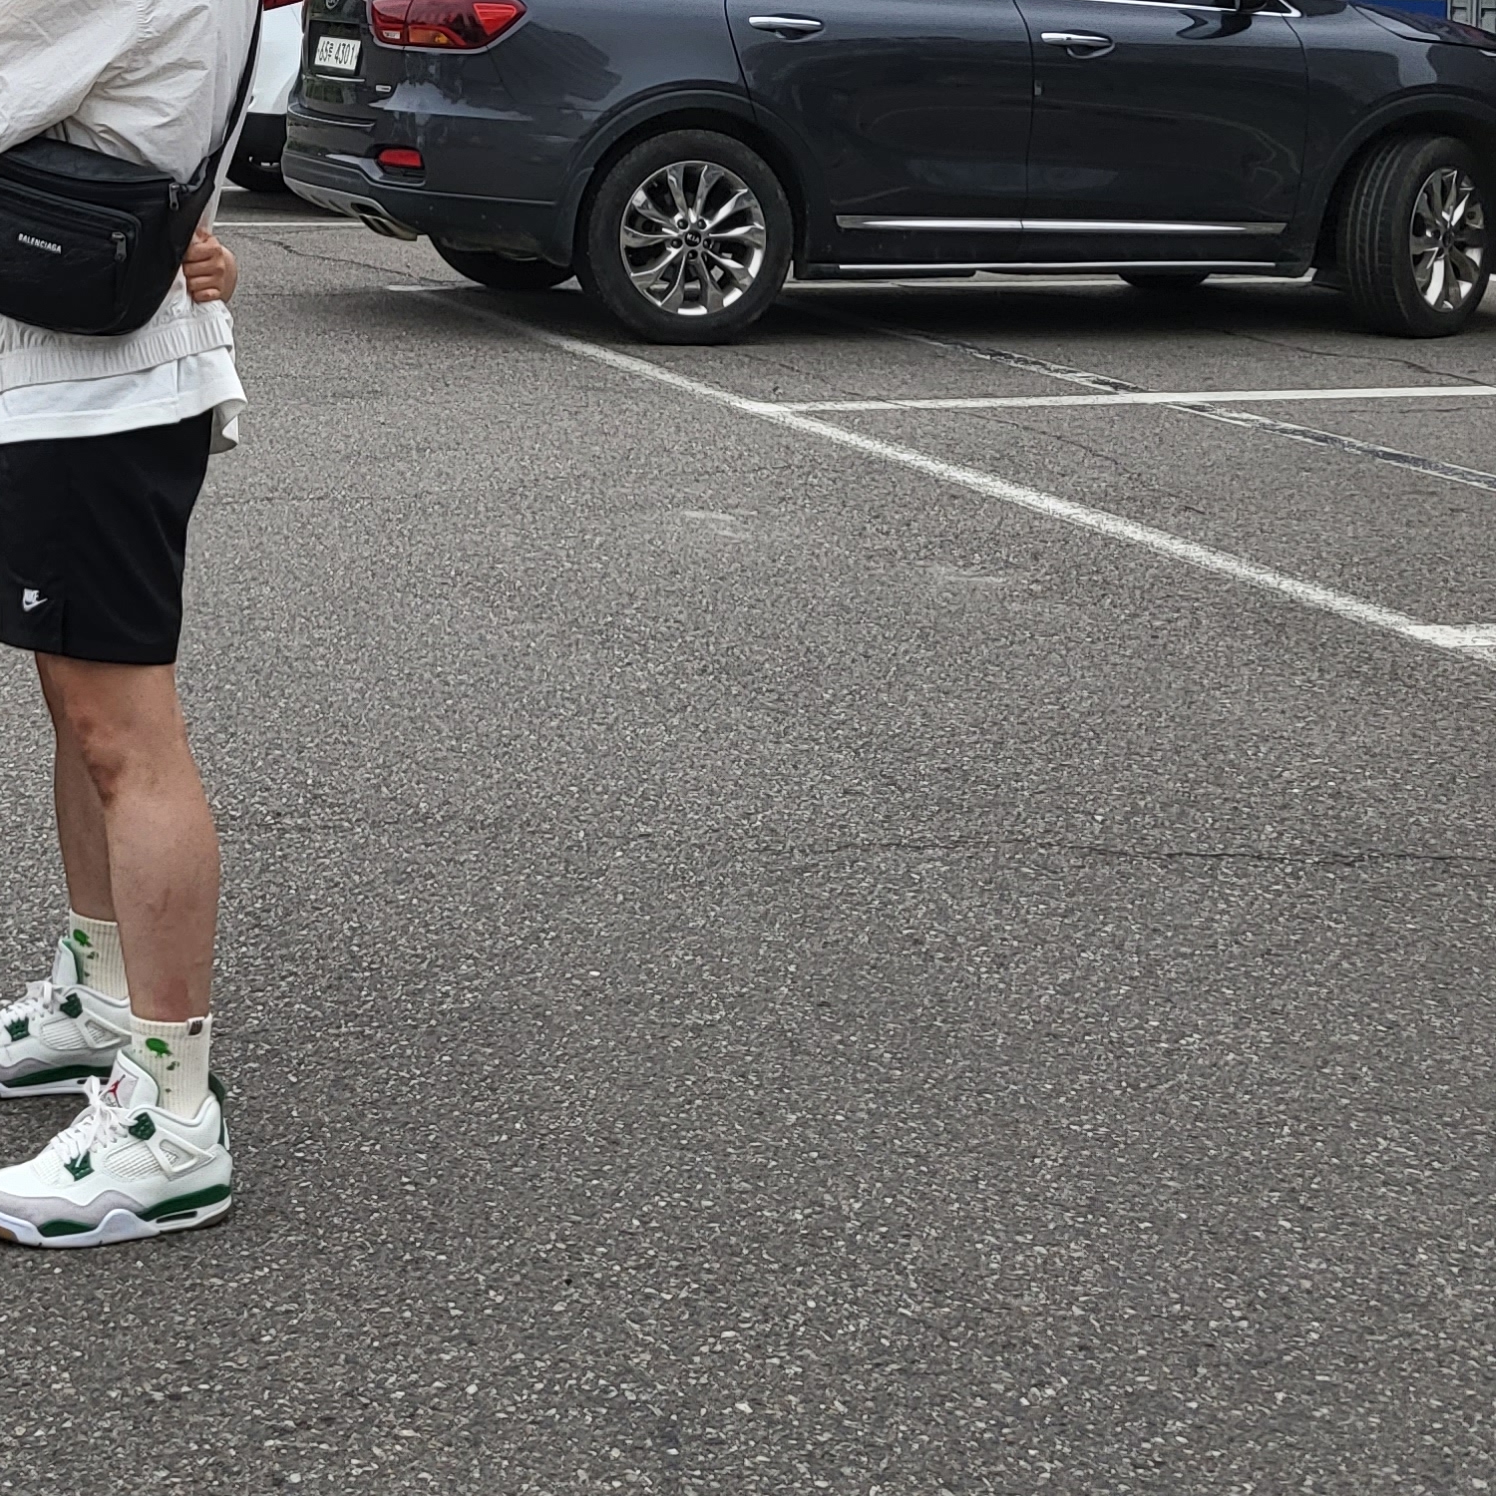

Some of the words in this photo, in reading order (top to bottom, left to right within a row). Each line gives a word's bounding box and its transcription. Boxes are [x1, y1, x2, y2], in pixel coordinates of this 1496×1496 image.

[334, 43, 356, 66] 4301
[18, 233, 62, 254] BALENCIAGA
[686, 233, 700, 244] KIA
